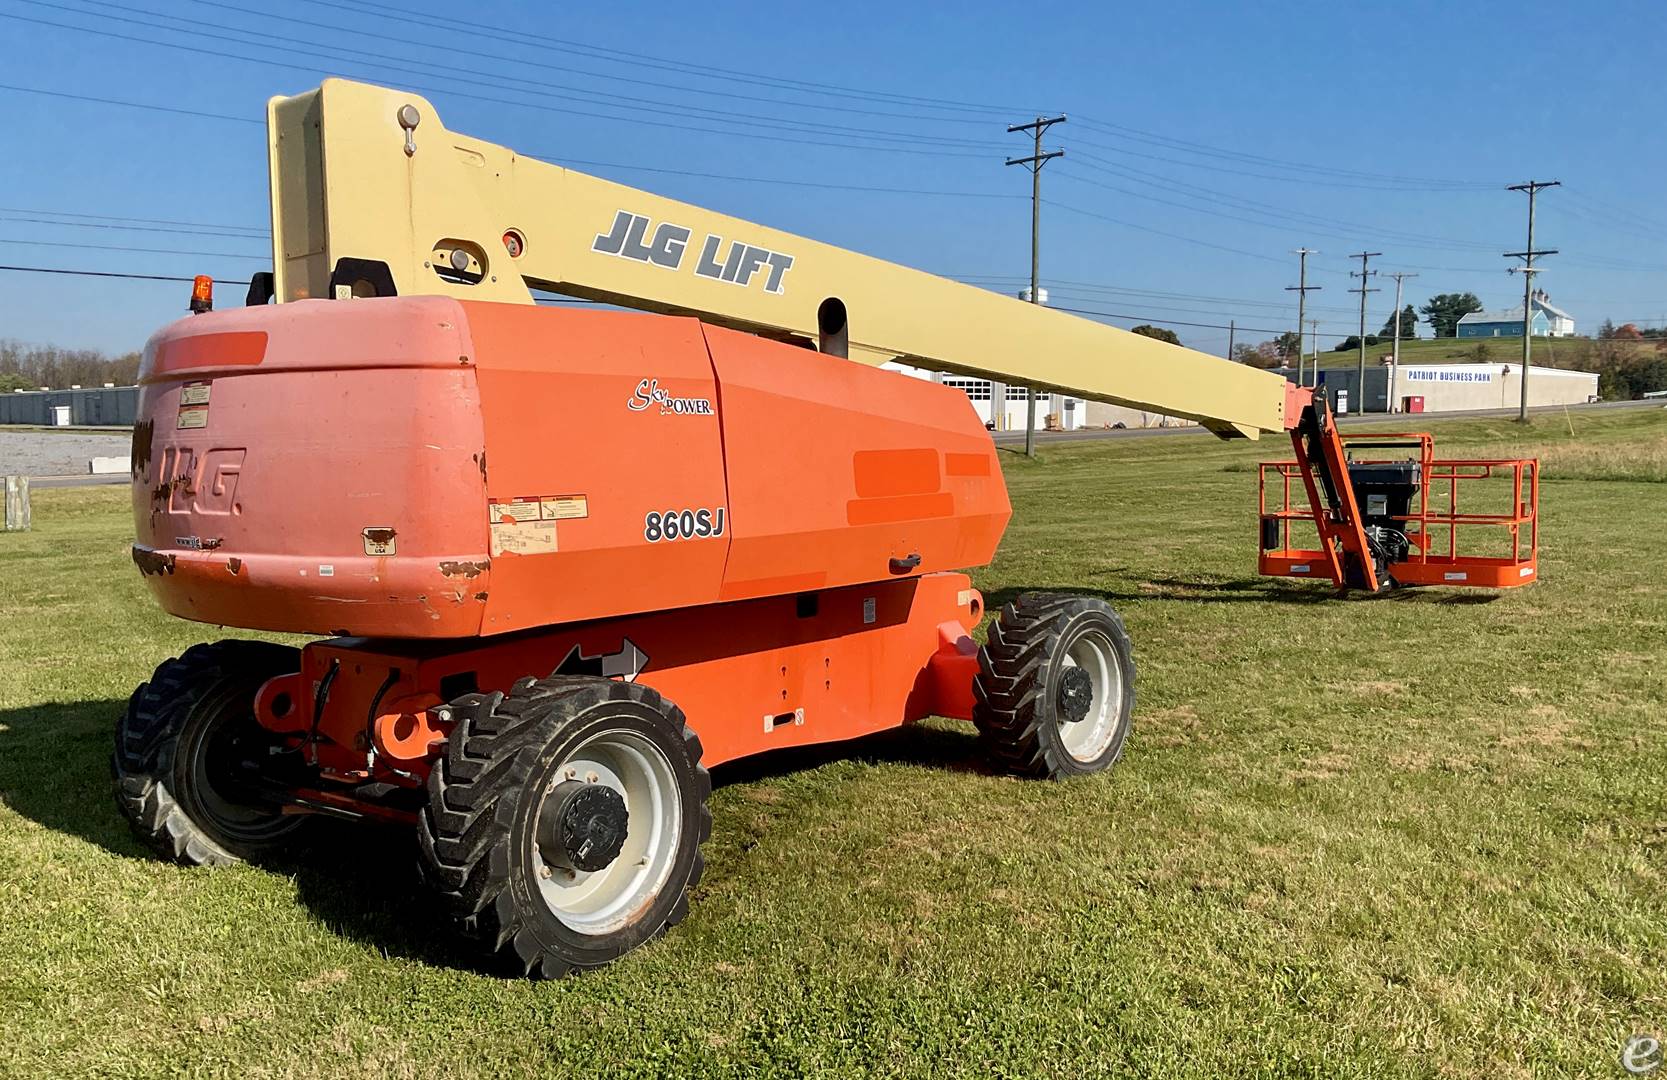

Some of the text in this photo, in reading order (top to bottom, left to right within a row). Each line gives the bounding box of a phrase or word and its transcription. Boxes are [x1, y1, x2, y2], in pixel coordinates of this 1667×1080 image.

[591, 209, 795, 293] JLG LIFT
[1408, 370, 1491, 382] PATRIOT BUSINESS PARK
[628, 379, 669, 411] Sky
[664, 398, 714, 415] POWER
[645, 508, 725, 542] 860SJ
